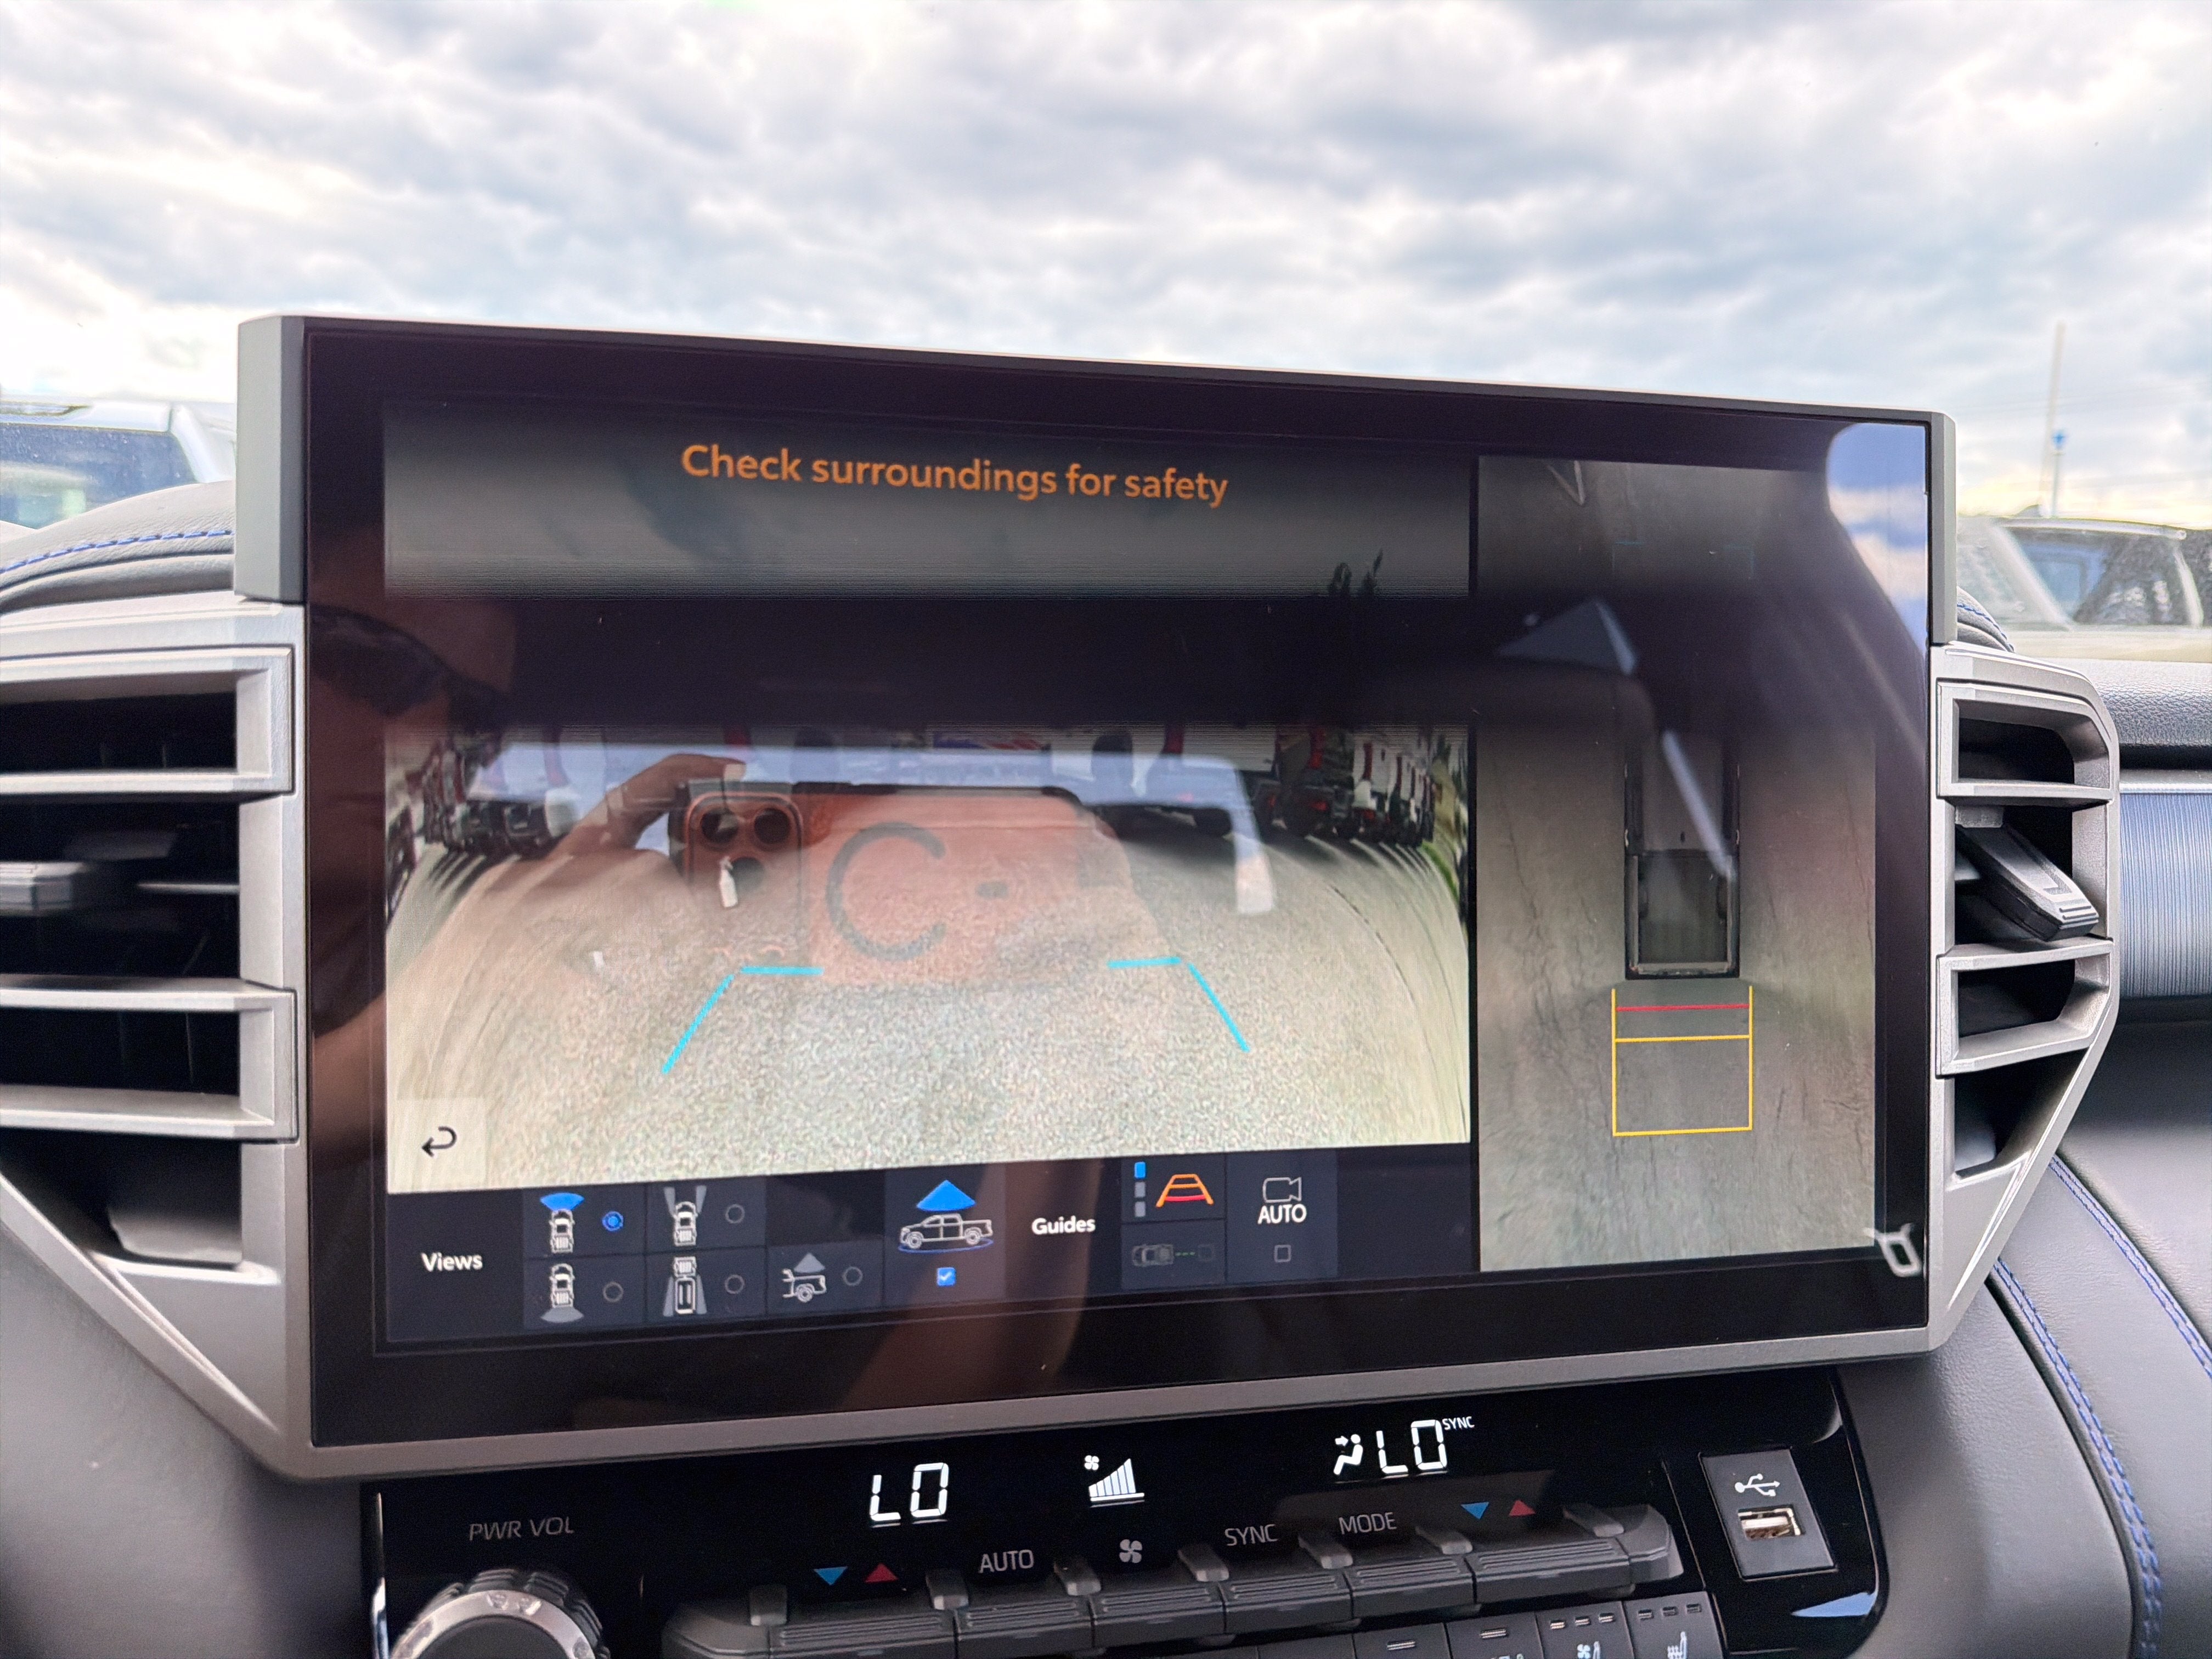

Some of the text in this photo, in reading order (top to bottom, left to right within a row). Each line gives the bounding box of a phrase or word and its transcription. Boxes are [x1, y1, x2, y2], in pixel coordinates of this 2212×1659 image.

[681, 444, 1228, 509] Check surroundings for safety
[1031, 1215, 1096, 1235] Guides
[1257, 1203, 1307, 1224] AUTO
[421, 1251, 483, 1272] Views
[1442, 1415, 1476, 1430] SYNC
[469, 1516, 574, 1542] PWR VOL
[1224, 1523, 1279, 1546] SYNC
[1338, 1511, 1397, 1535] MODE
[979, 1549, 1035, 1574] AUTO
